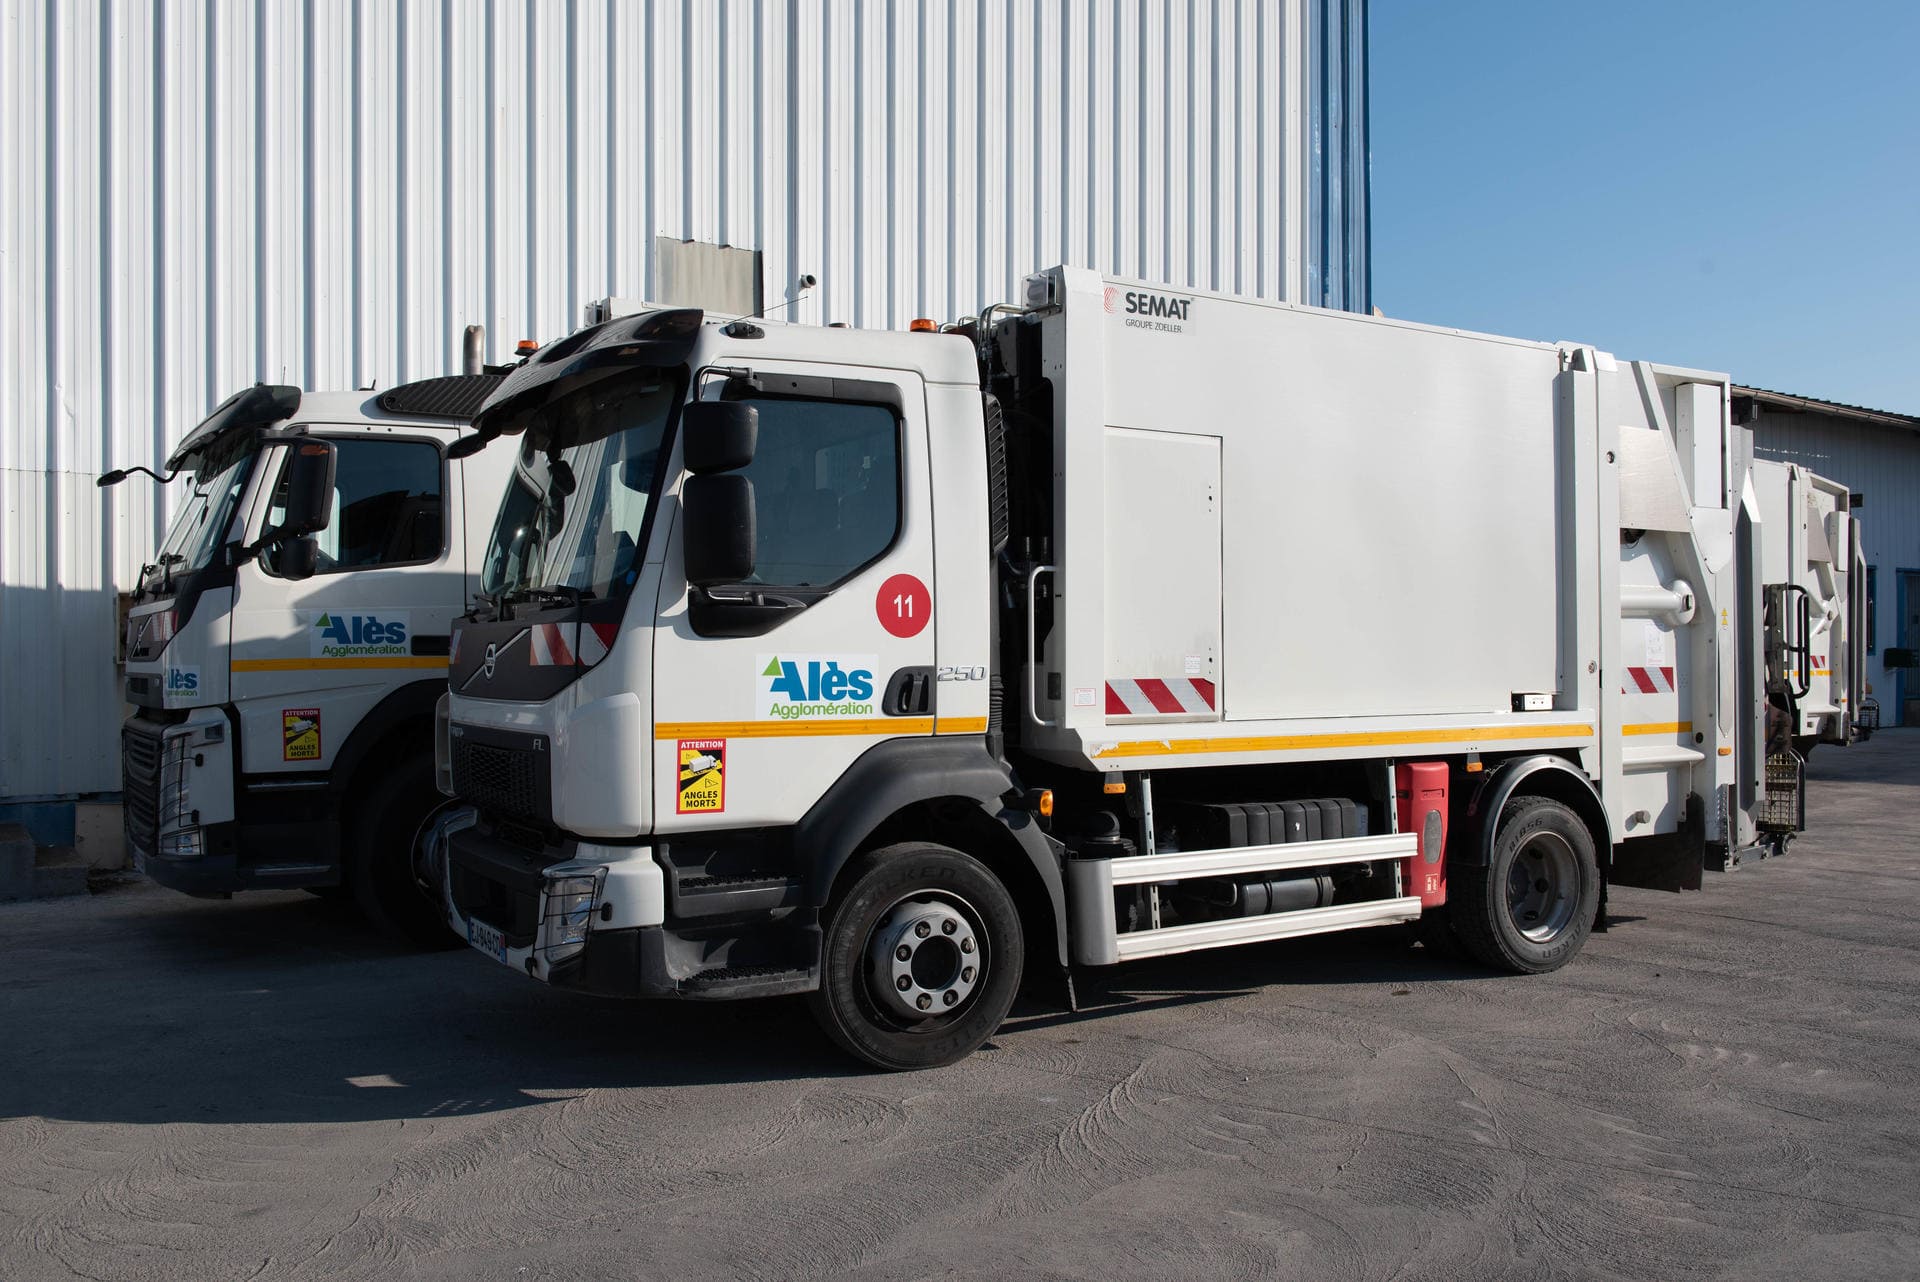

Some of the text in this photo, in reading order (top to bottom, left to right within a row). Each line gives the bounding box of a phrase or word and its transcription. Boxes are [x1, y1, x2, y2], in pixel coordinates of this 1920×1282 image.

[1125, 292, 1190, 320] SEMAT
[1125, 319, 1182, 333] GROUPE ZOELLER
[893, 594, 913, 618] 11
[317, 613, 406, 644] Alès
[322, 645, 406, 657] Agglomération
[765, 660, 873, 701] Alès
[937, 666, 985, 682] 250
[769, 702, 873, 719] Agglomération
[681, 740, 724, 749] ATTENTION
[684, 790, 718, 799] ANGLES
[686, 799, 716, 808] MORTS
